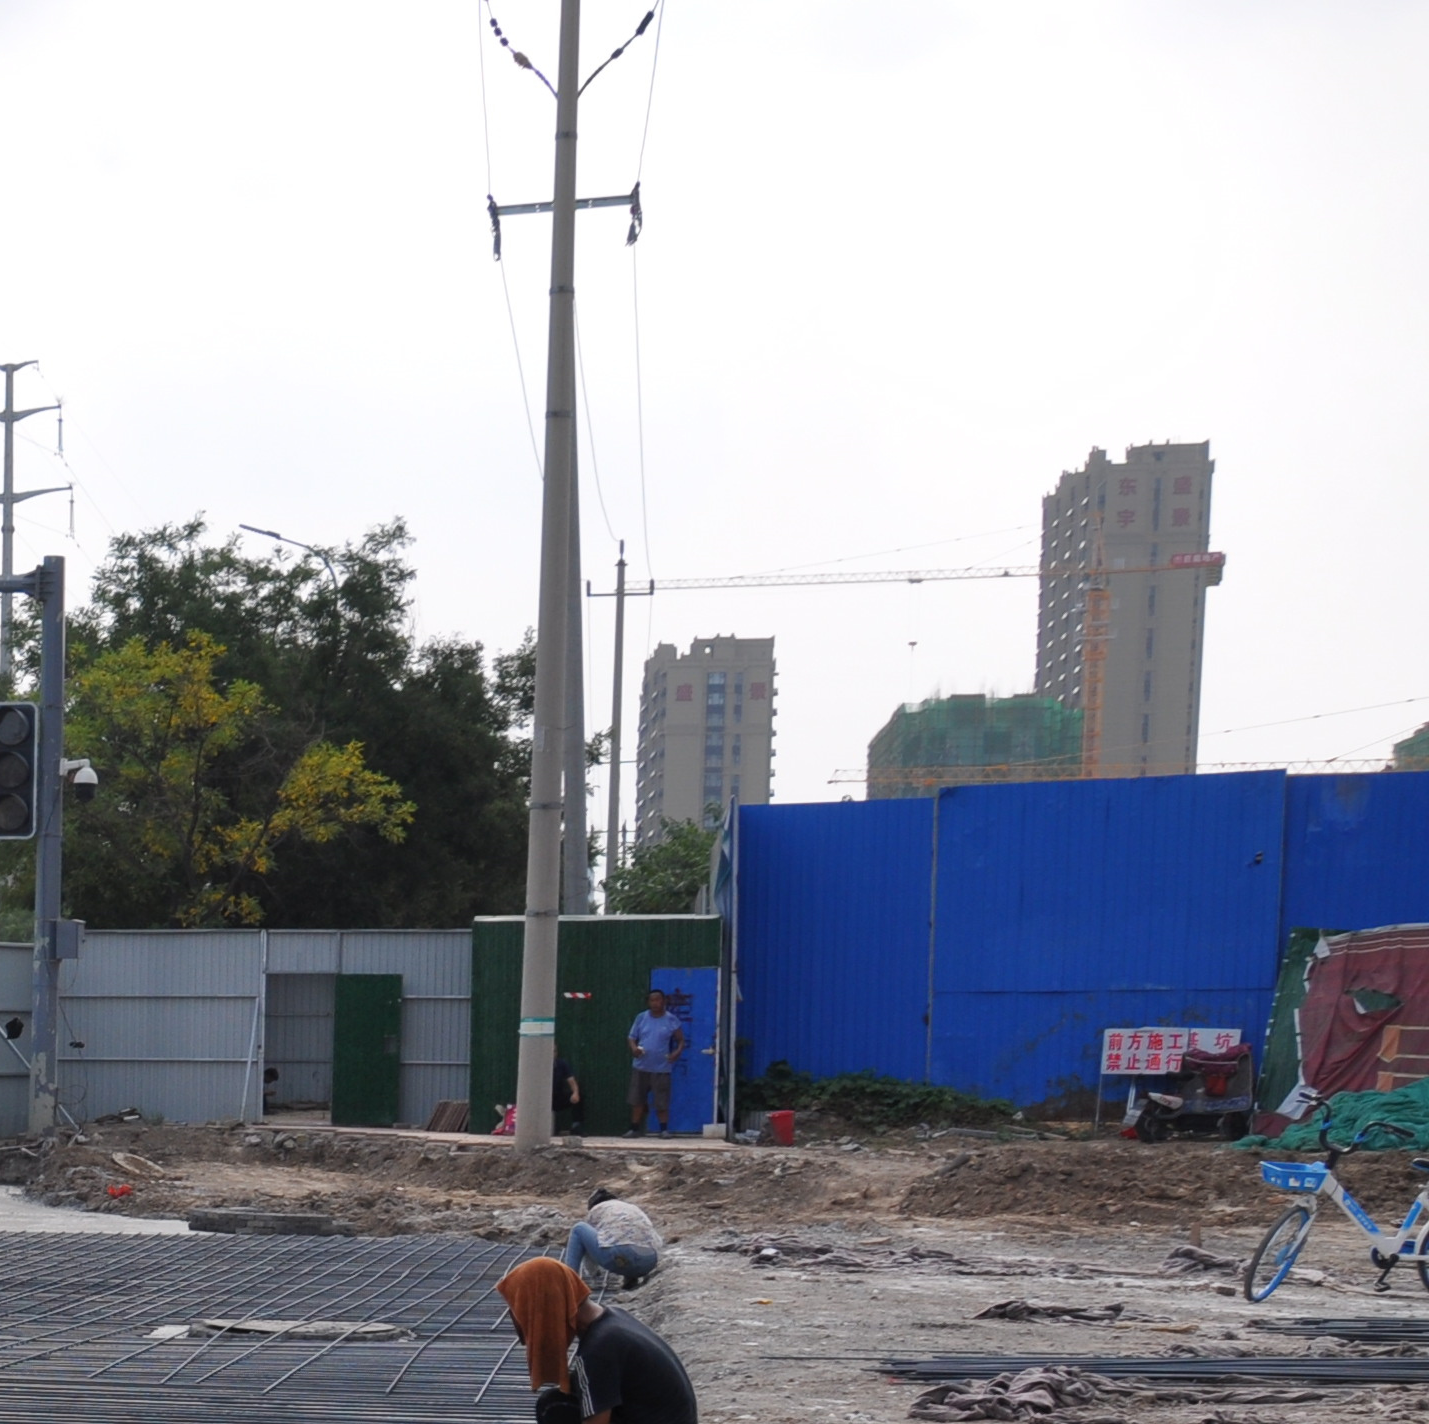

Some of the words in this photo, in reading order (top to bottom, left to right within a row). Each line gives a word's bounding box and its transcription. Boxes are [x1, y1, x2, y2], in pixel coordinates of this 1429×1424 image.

[1108, 1033, 1183, 1050] 前方施工
[1106, 1053, 1183, 1071] 禁止通行
